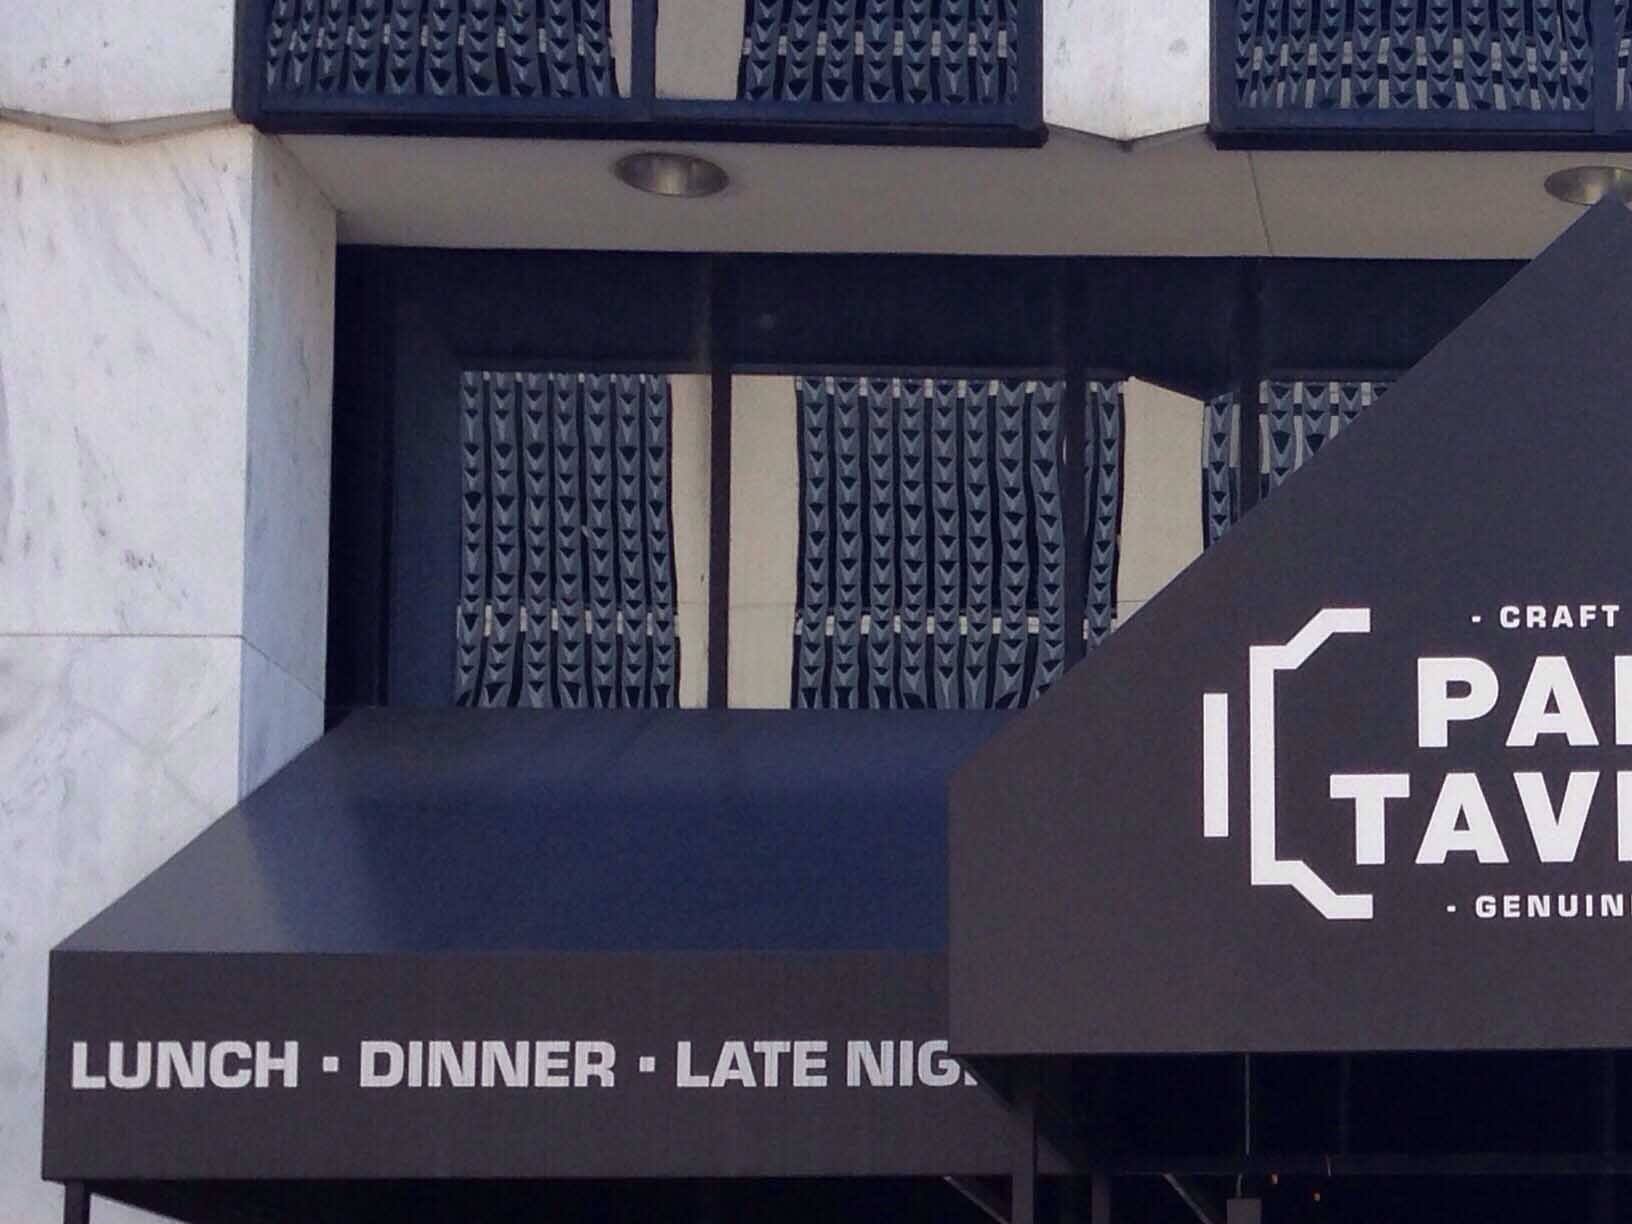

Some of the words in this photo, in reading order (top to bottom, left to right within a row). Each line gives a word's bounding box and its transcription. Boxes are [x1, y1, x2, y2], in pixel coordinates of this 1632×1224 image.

[1499, 604, 1620, 629] CRAFT
[71, 1040, 299, 1089] LUNCH
[359, 1040, 616, 1088] DINNER
[676, 1040, 828, 1088] LATE
[846, 1039, 978, 1087] NIG
